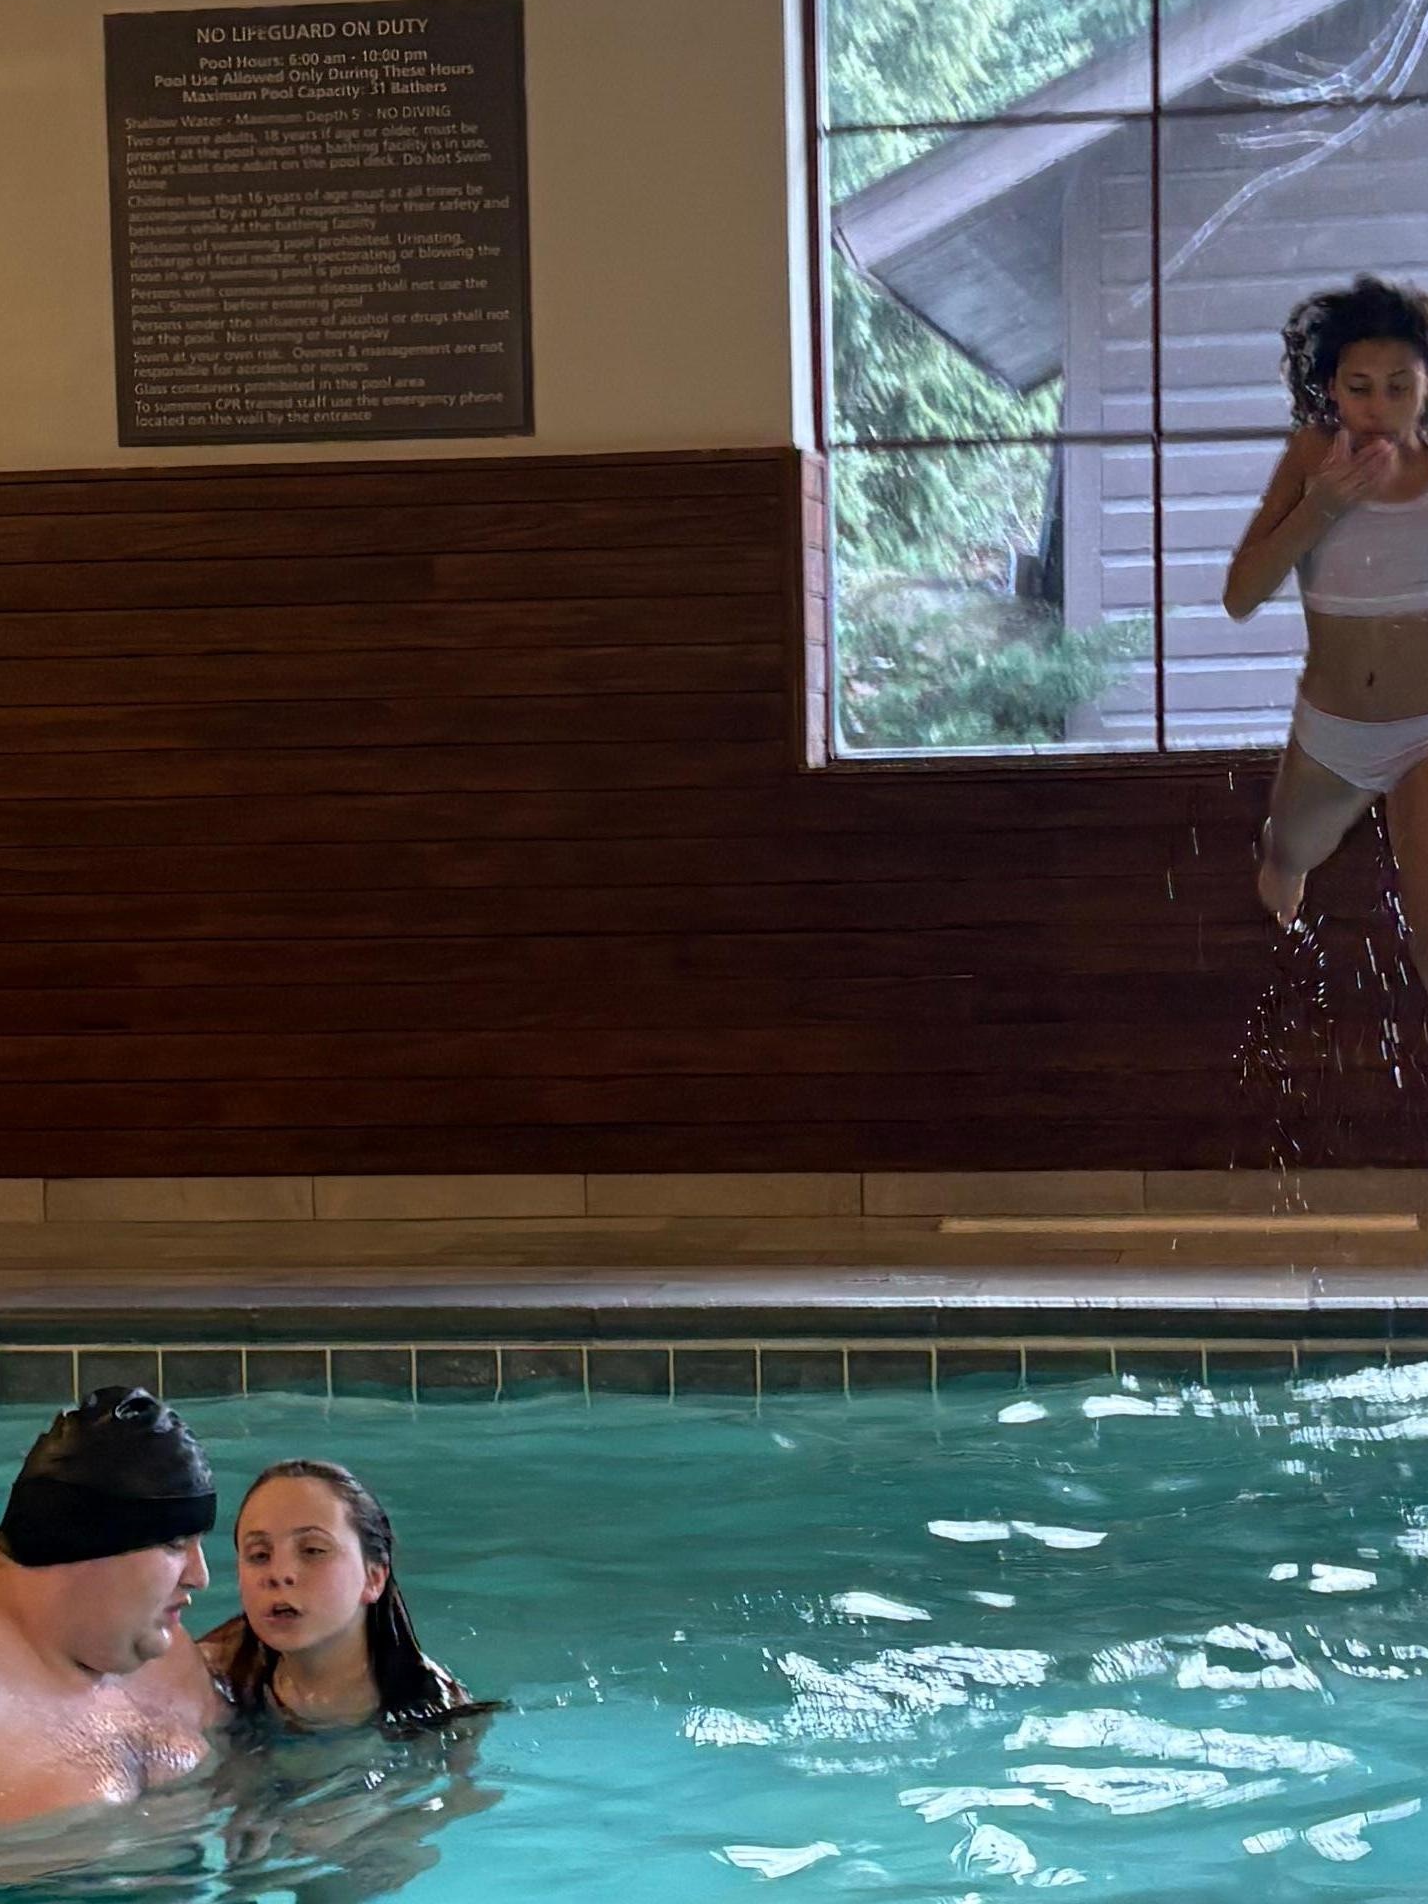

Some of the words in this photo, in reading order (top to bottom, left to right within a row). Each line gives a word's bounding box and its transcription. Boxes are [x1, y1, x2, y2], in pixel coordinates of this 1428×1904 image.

[196, 26, 225, 43] NO
[232, 21, 335, 42] LIFEGUARD
[341, 20, 371, 37] ON
[377, 17, 428, 35] DUTY
[199, 56, 231, 69] Pool
[288, 52, 319, 66] 6:00
[322, 53, 346, 64] am
[362, 48, 400, 62] 10:00
[403, 49, 427, 64] pm
[154, 73, 186, 87] Pool
[191, 72, 218, 86] Use
[288, 67, 323, 85] Only
[328, 65, 378, 83] During
[382, 63, 425, 78] These
[430, 61, 474, 76] Hours
[260, 86, 293, 100] Pool
[368, 82, 385, 95] 31
[390, 79, 447, 94] Bathers
[305, 109, 348, 124] Depth
[376, 106, 398, 119] NO
[401, 104, 451, 118] DIVING
